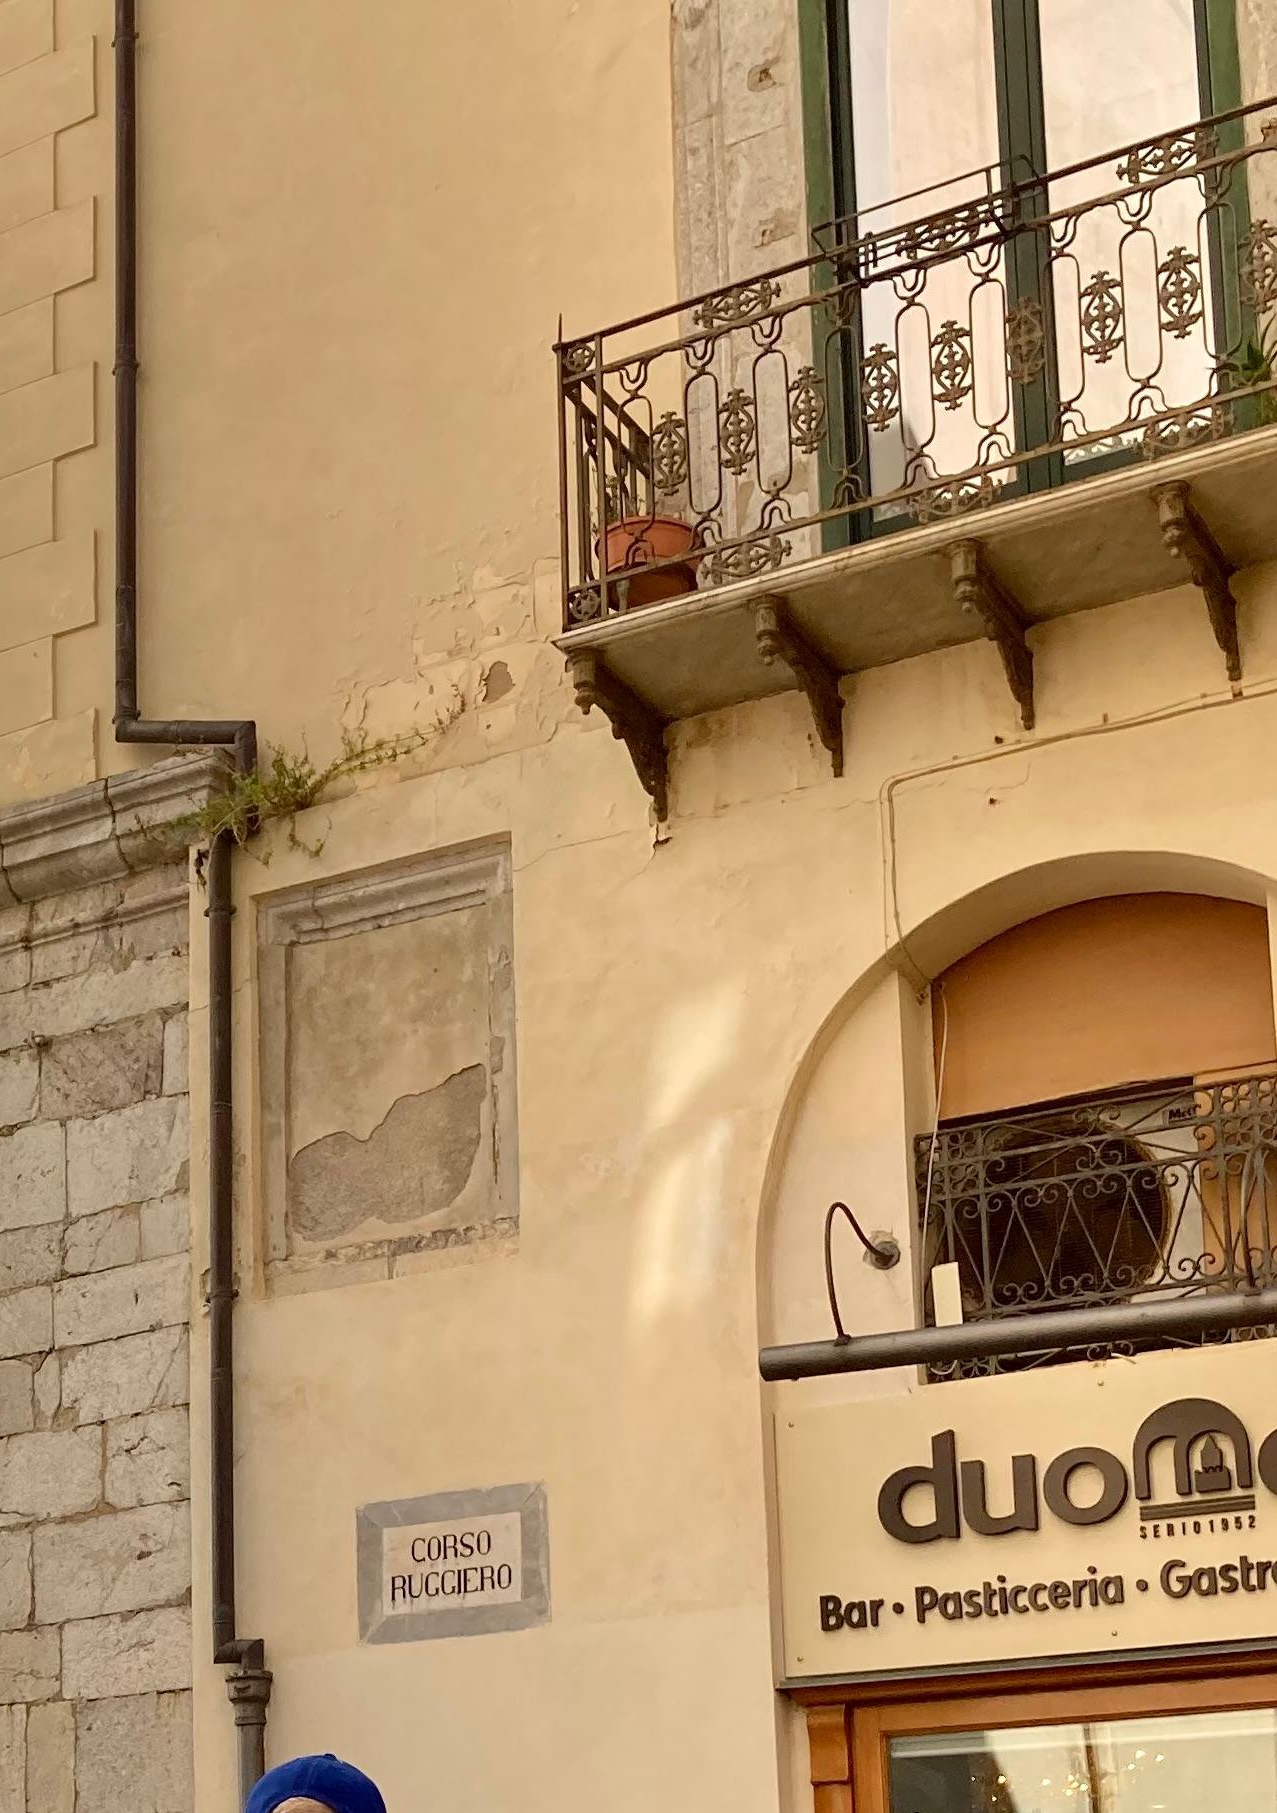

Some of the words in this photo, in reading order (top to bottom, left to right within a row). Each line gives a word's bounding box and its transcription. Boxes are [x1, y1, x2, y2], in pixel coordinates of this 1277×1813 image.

[411, 1530, 491, 1562] CORSO
[391, 1564, 512, 1602] RUGGIERO
[819, 1595, 884, 1632] Bar
[915, 1566, 1124, 1624] Pasticceria
[1160, 1555, 1277, 1599] Gastr
